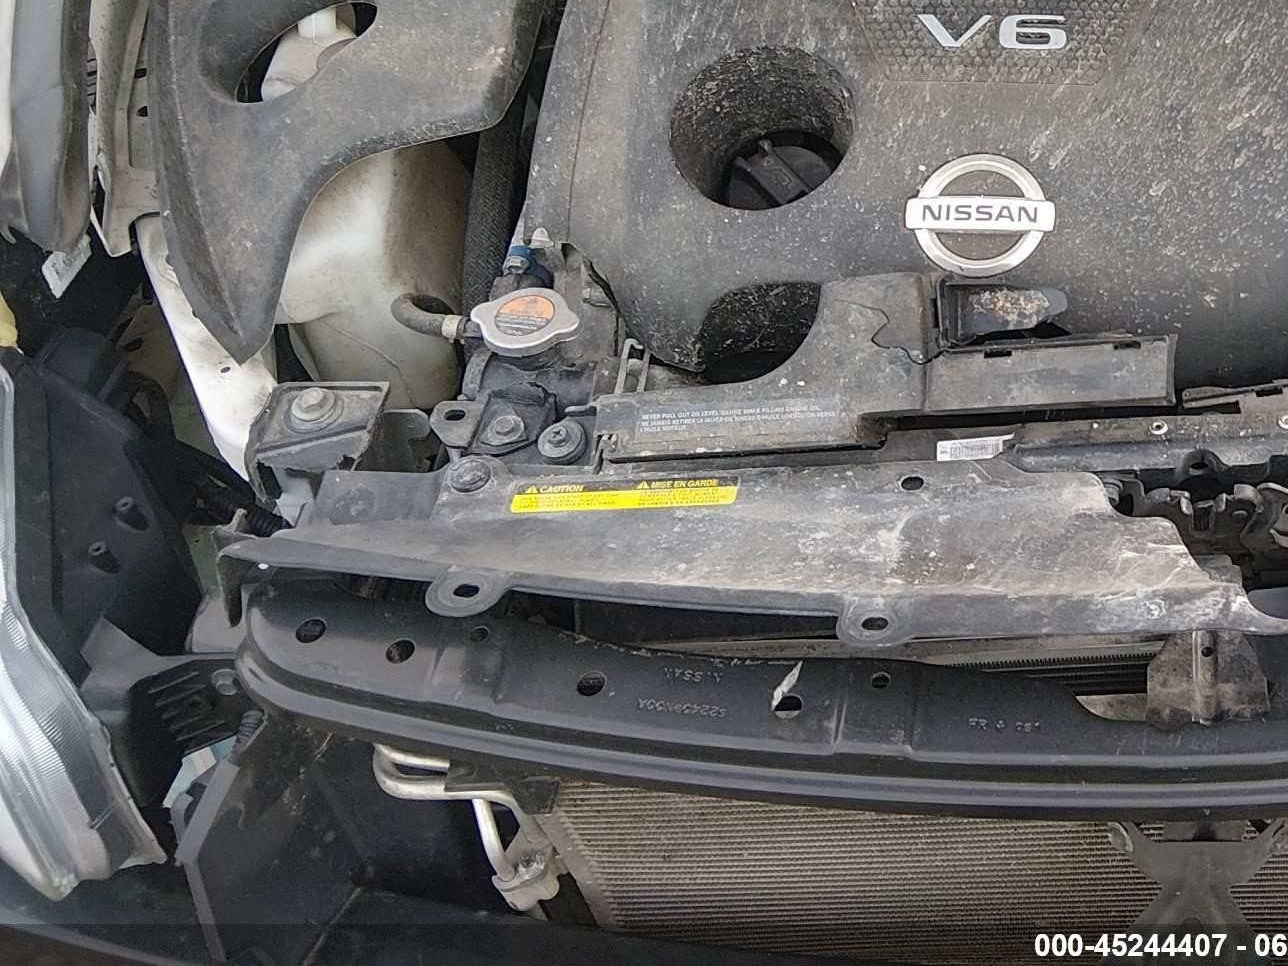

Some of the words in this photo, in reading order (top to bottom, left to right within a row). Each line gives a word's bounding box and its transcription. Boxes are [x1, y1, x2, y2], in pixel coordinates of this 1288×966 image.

[917, 14, 1067, 50] V6
[922, 204, 1038, 223] NISSAN
[540, 484, 584, 494] CAUTION
[651, 480, 674, 489] MISE
[674, 480, 687, 488] EN
[687, 479, 720, 487] GARDE
